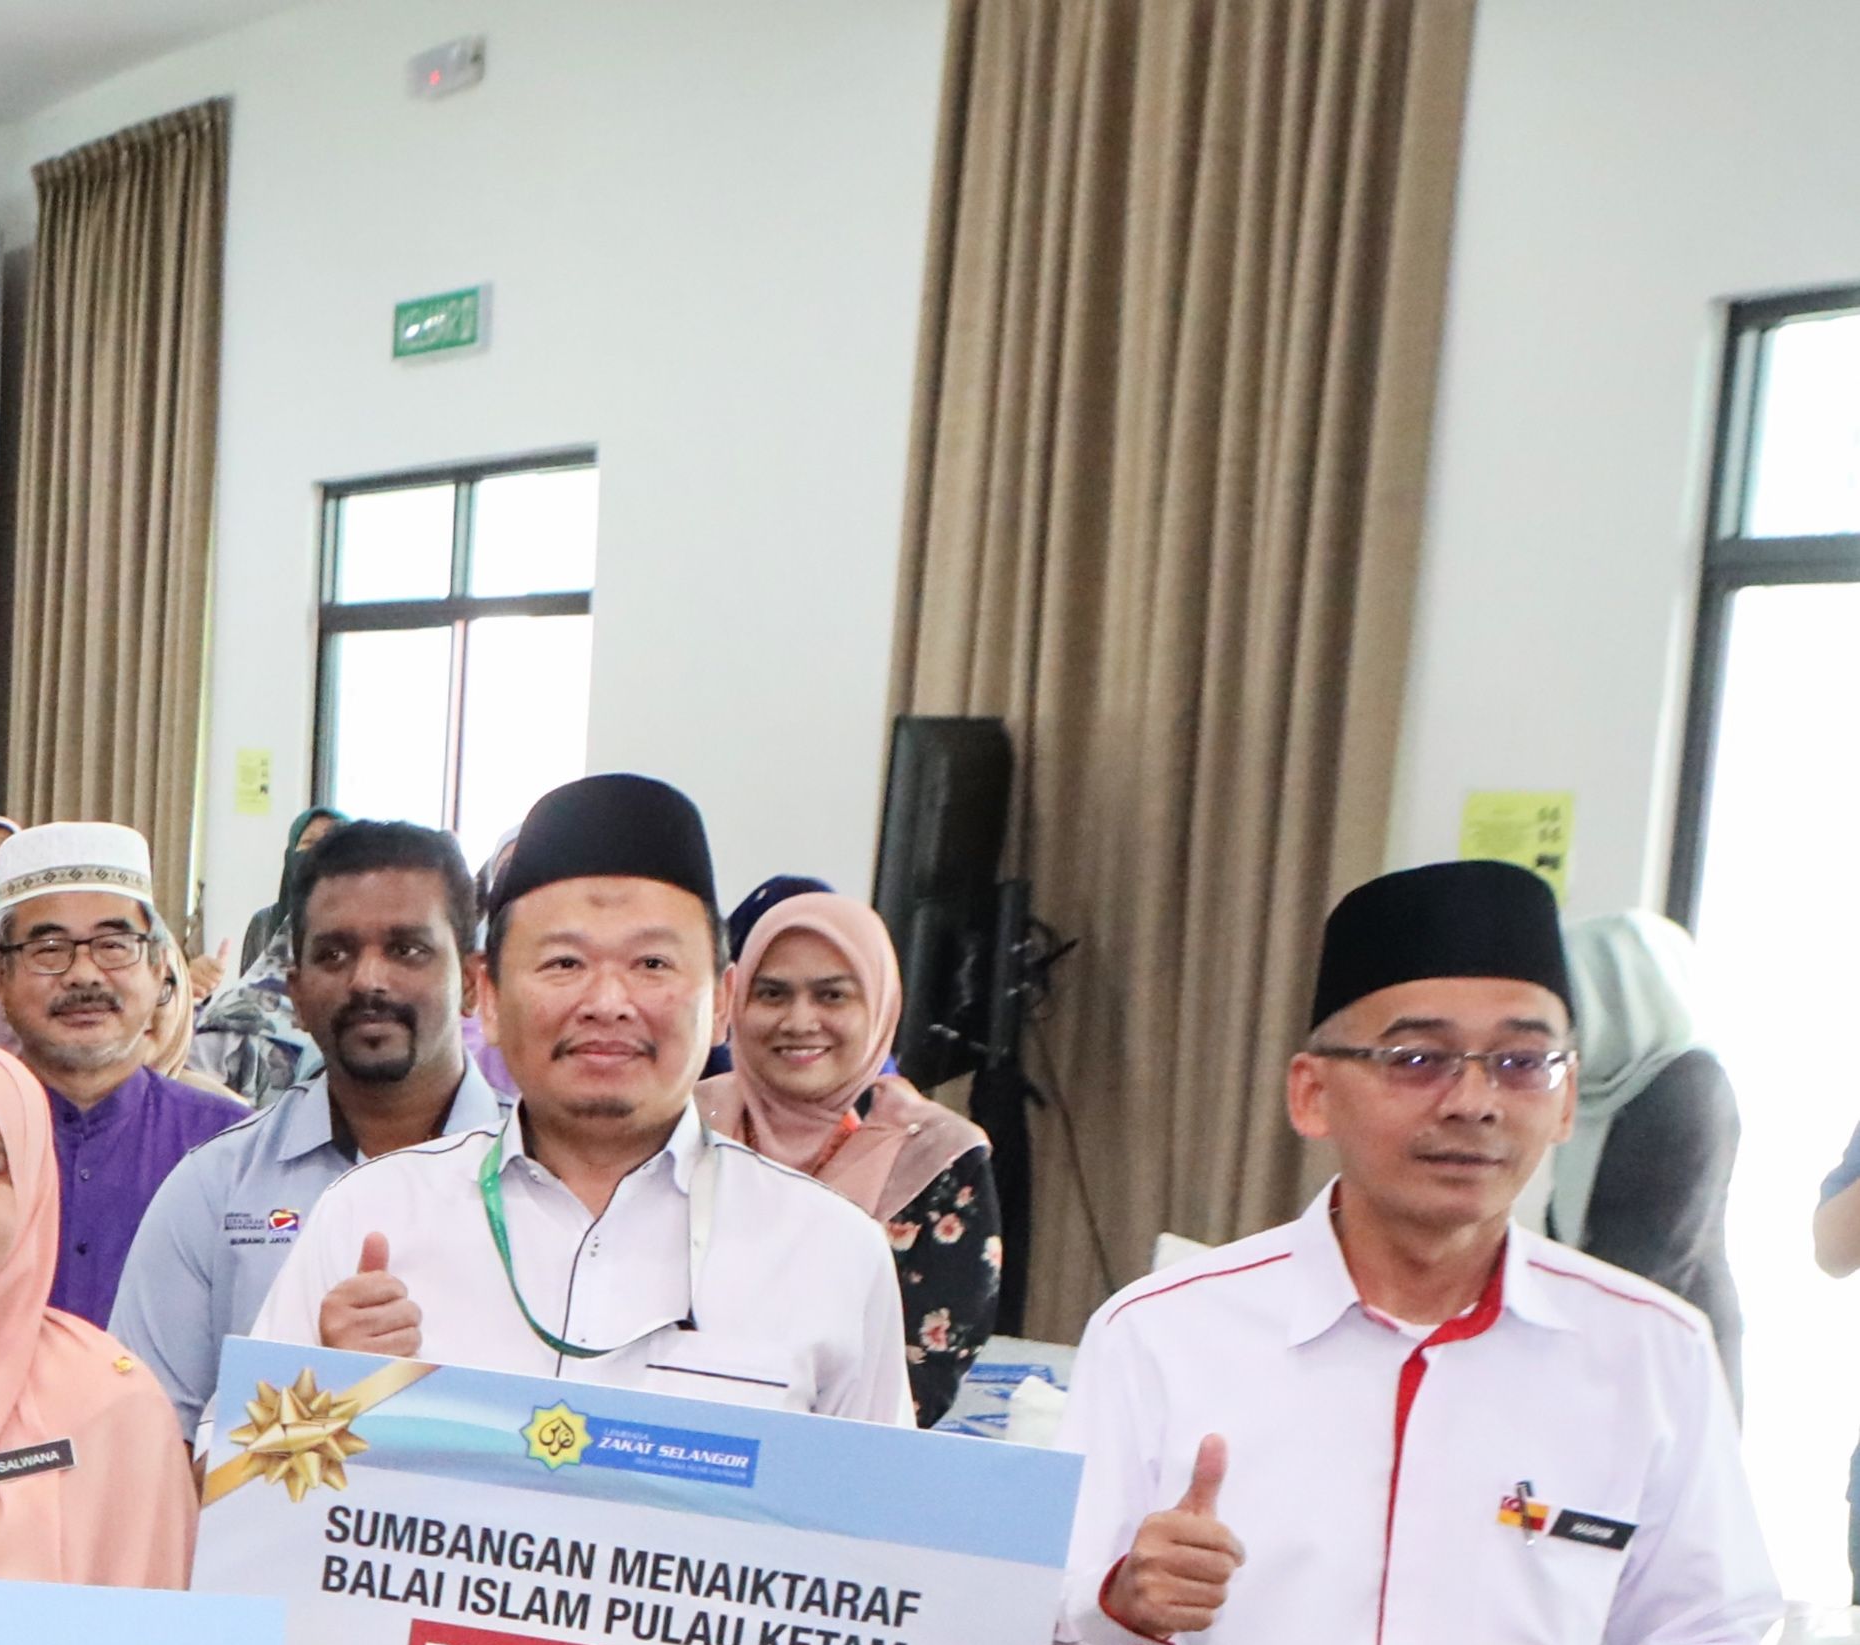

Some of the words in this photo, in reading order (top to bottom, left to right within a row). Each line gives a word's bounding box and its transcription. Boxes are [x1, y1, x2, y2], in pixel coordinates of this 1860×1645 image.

[598, 1436, 656, 1454] ZAKAT
[658, 1444, 750, 1468] SELANGOR
[323, 1556, 444, 1607] BALAI
[459, 1576, 590, 1629] ISLAM
[326, 1506, 595, 1579] SUMBANGAN
[610, 1548, 920, 1627] MENAIKTARAF
